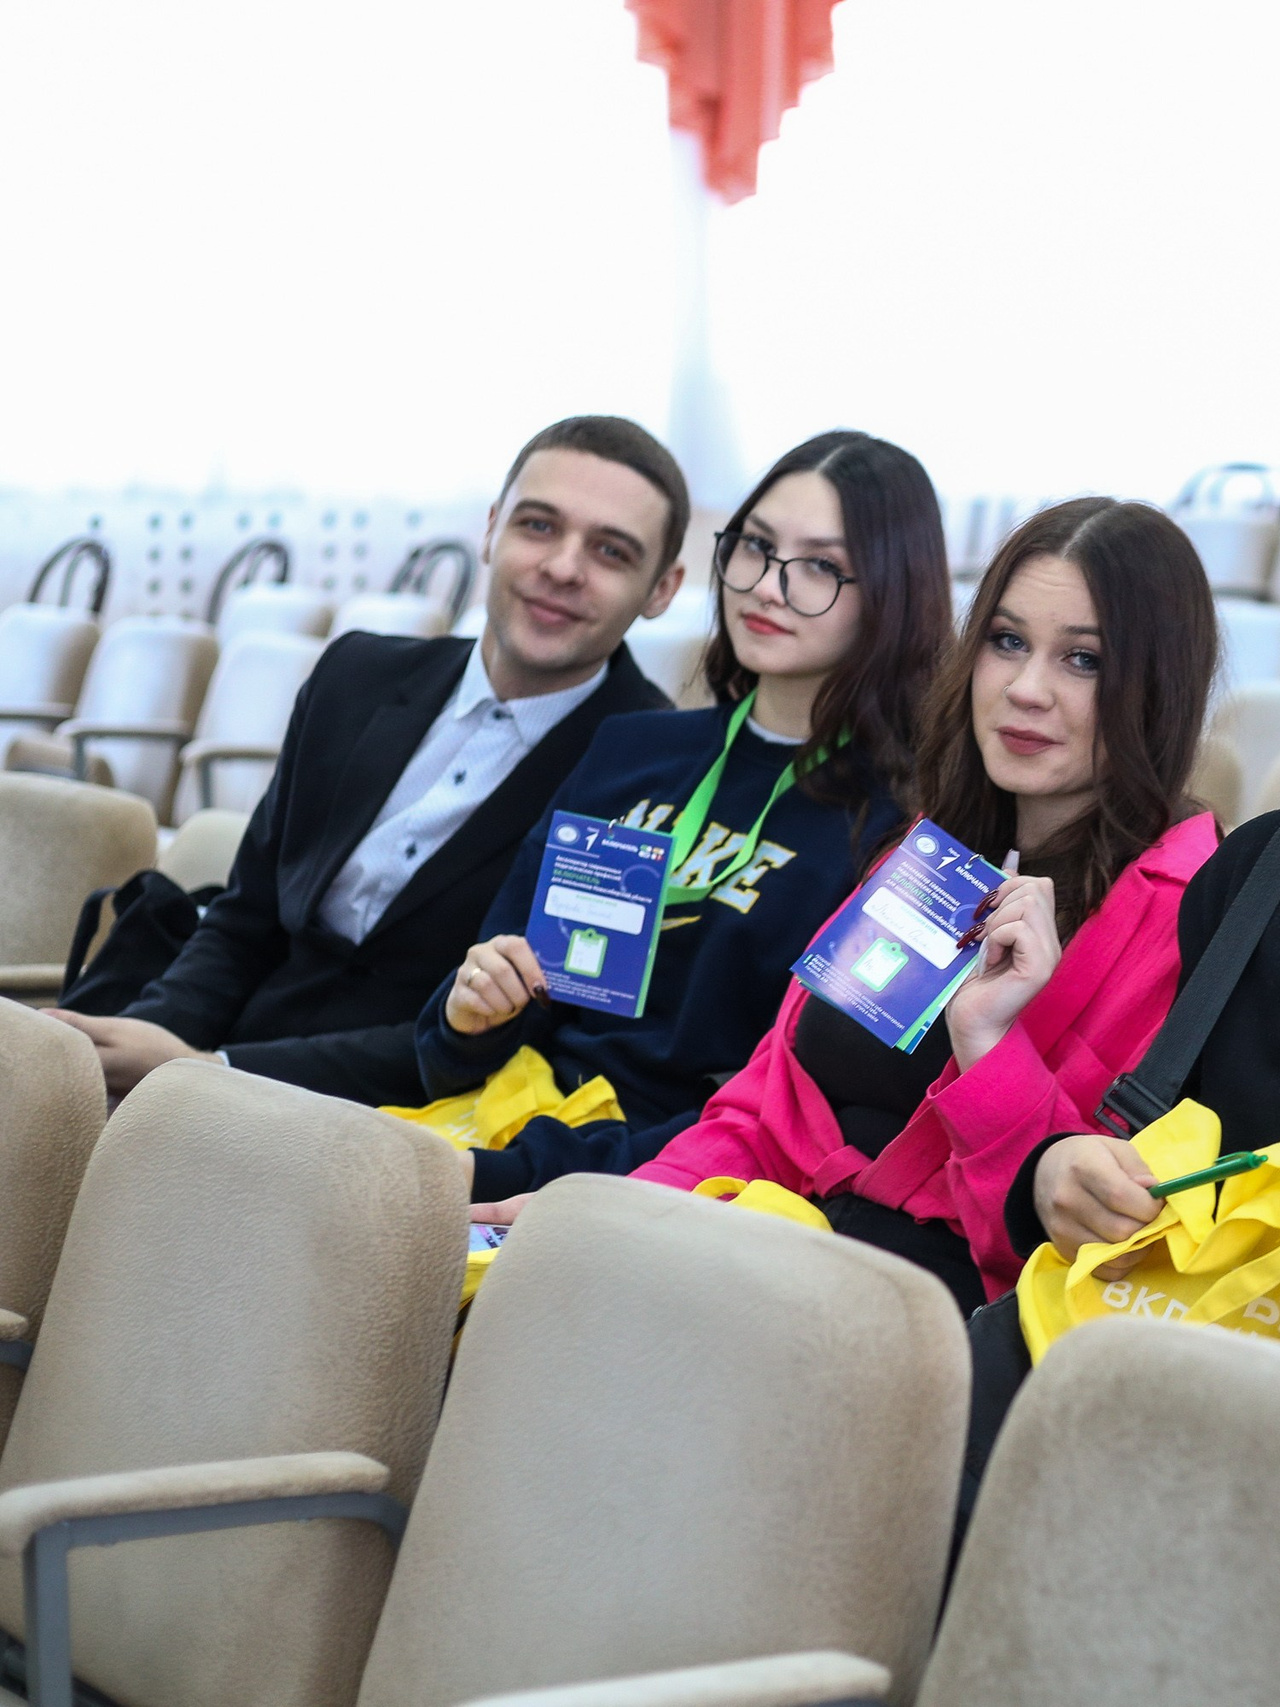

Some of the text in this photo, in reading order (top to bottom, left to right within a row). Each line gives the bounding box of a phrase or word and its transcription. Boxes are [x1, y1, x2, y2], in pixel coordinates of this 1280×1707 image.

[624, 798, 797, 915] NKE
[889, 870, 935, 906] ВКЛЮЧАТЕЛЬ
[954, 864, 990, 894] ВКЛЮЧАТЕЛЬ
